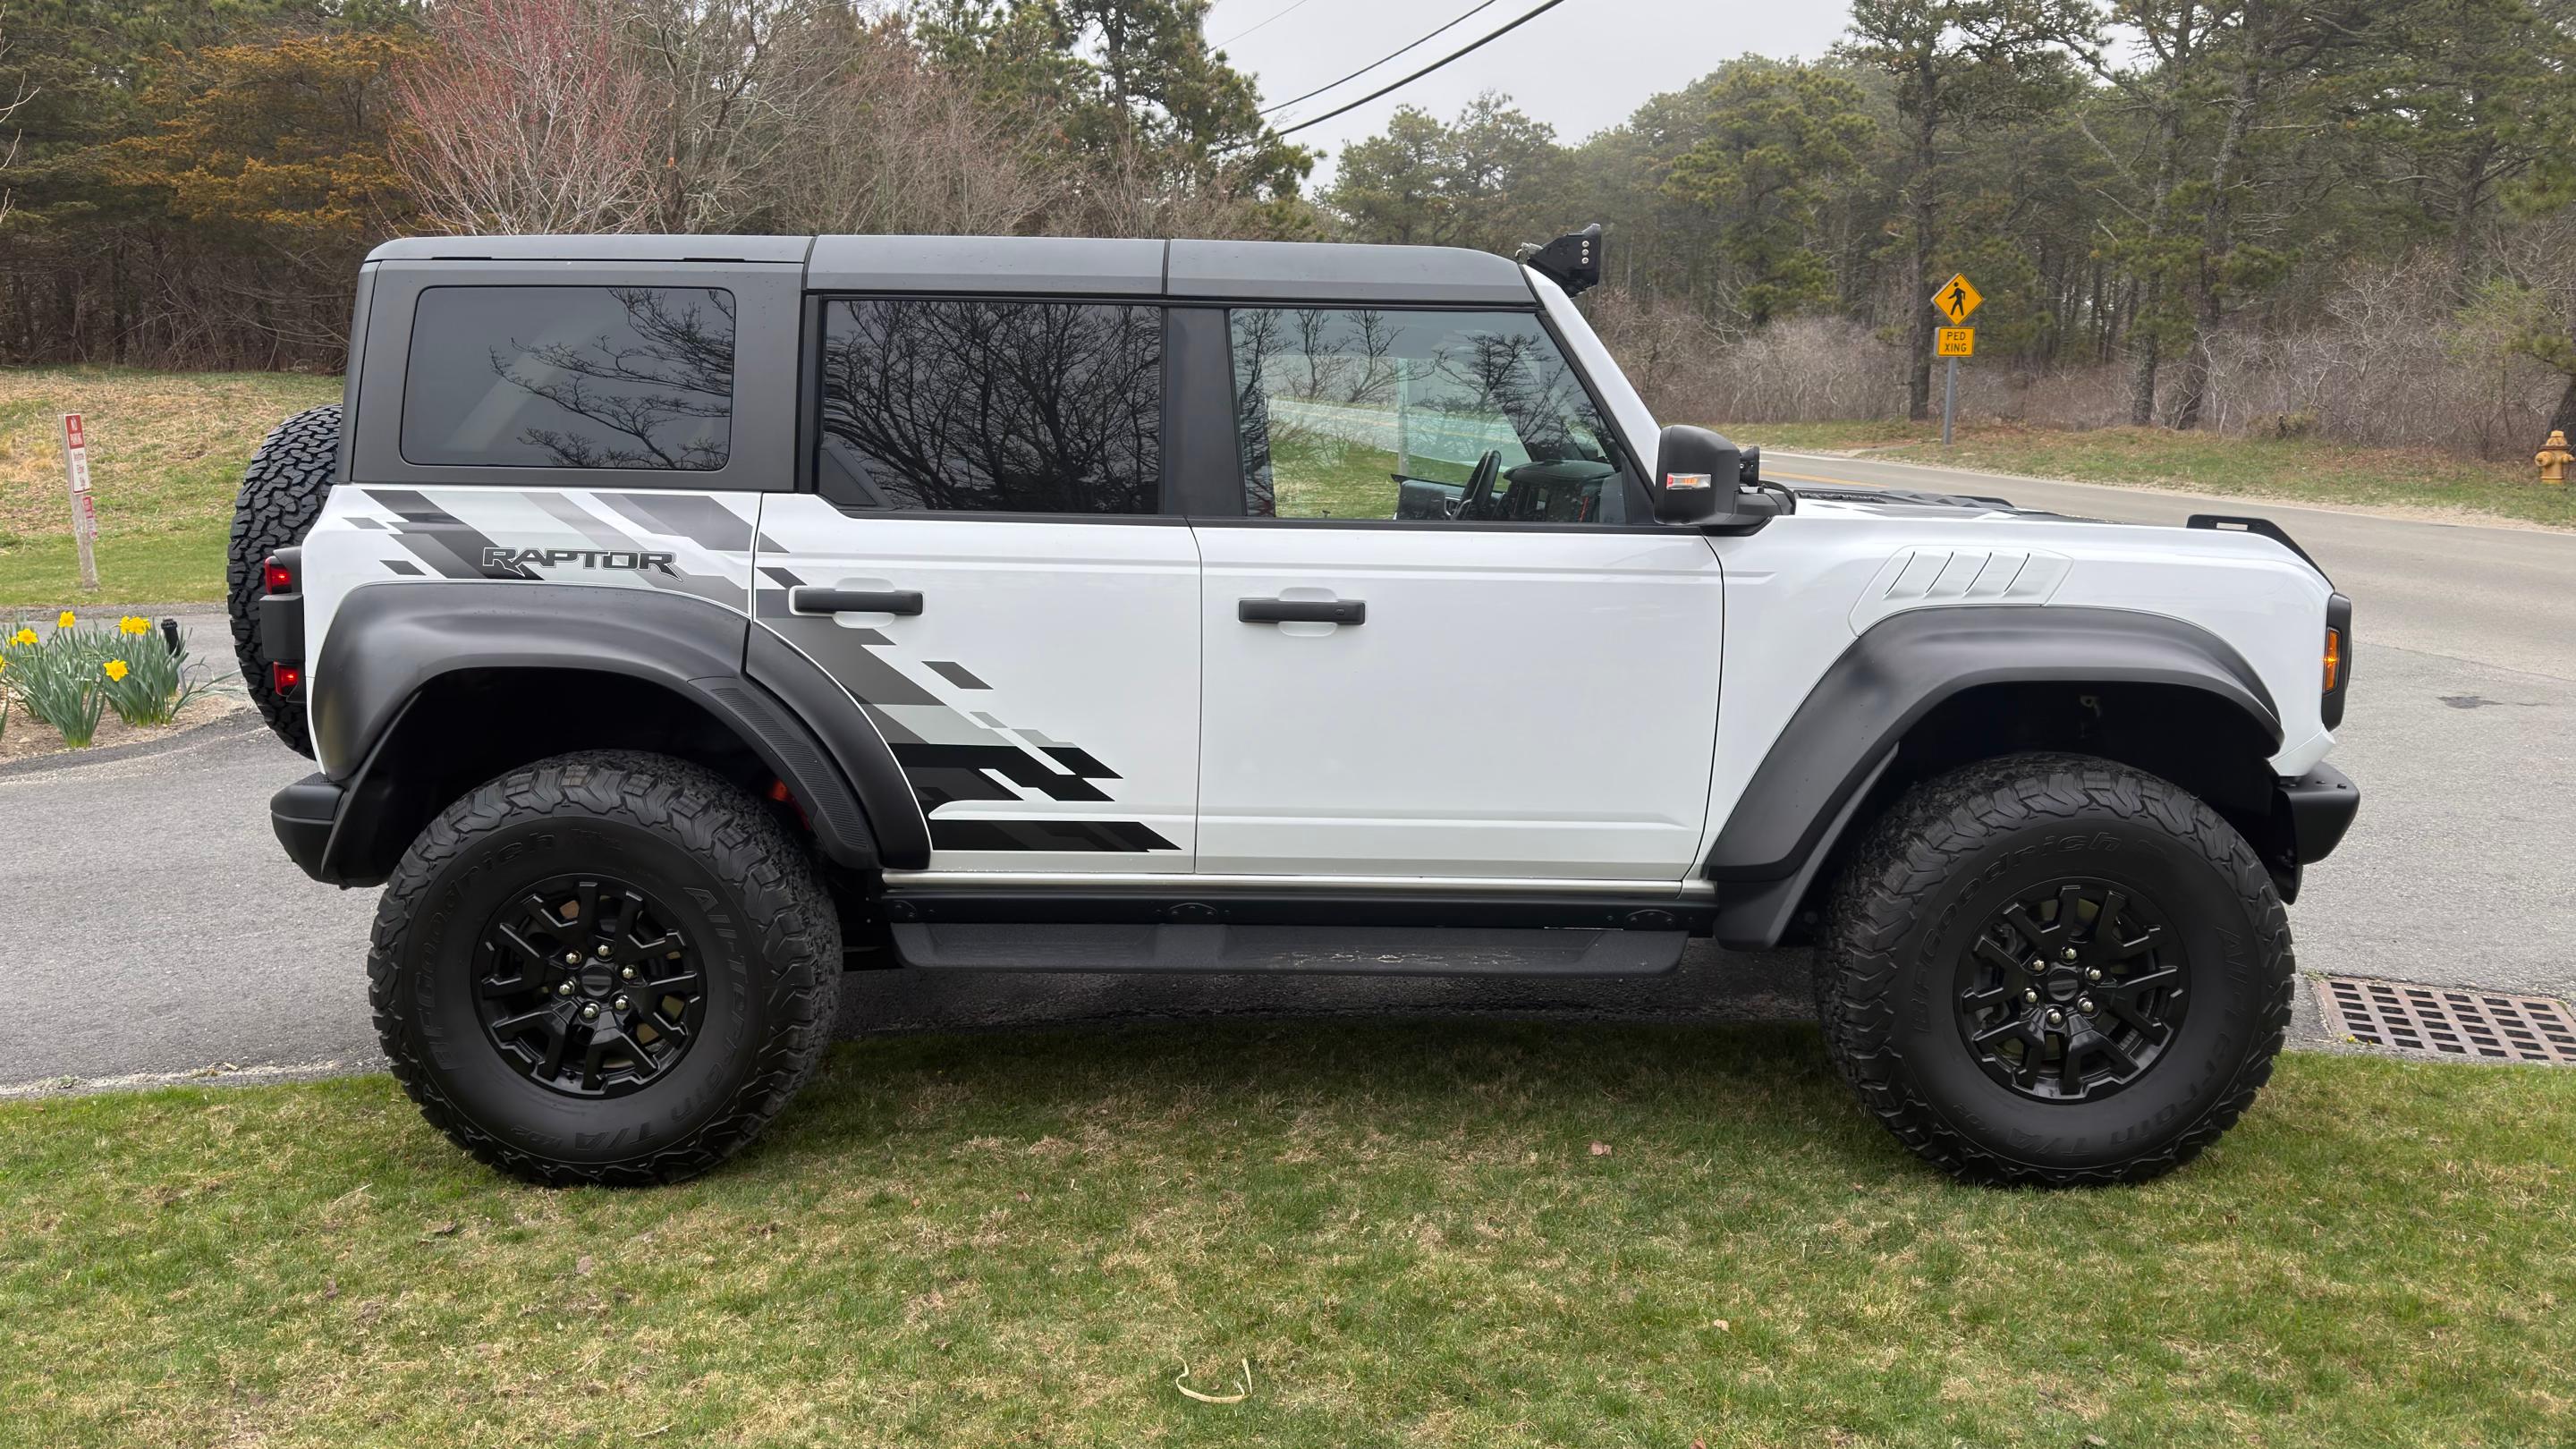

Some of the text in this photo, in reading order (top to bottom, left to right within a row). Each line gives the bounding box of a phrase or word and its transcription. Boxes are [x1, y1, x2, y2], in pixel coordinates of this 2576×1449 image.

[1946, 332, 1966, 341] PED
[1945, 343, 1967, 352] XING
[482, 547, 683, 582] RAPTOR
